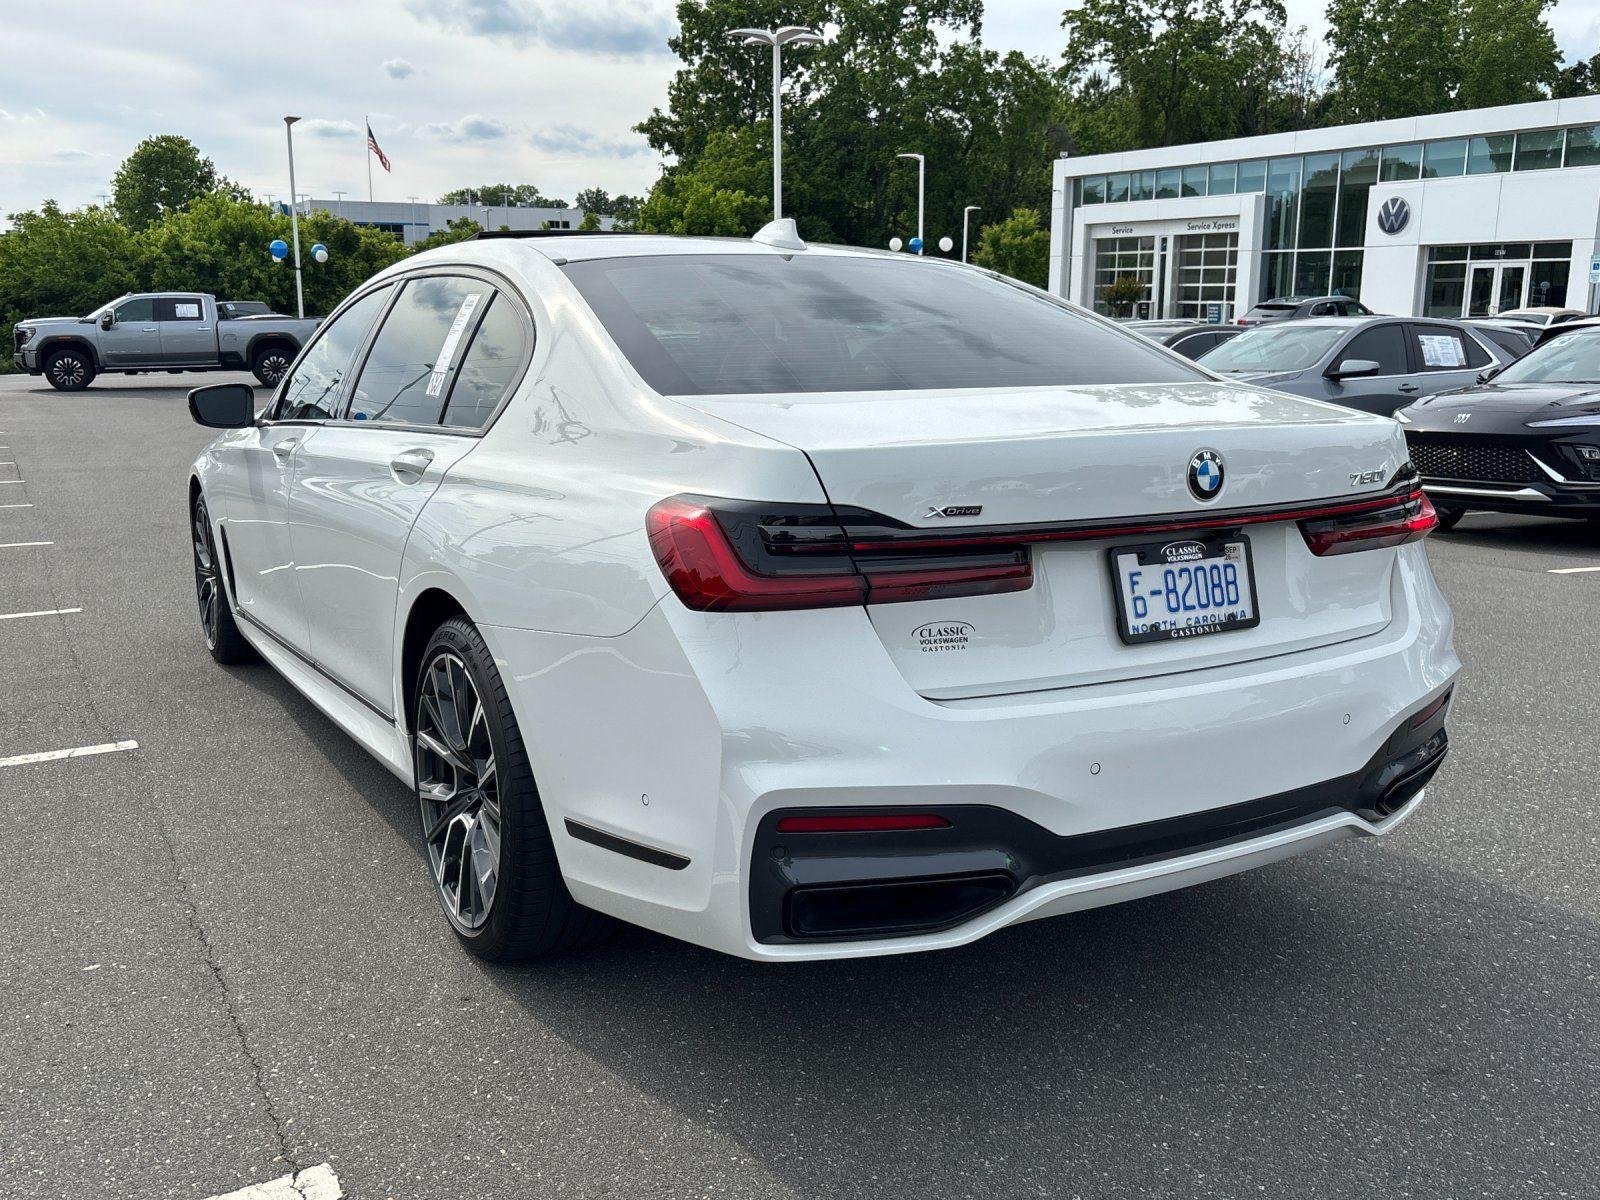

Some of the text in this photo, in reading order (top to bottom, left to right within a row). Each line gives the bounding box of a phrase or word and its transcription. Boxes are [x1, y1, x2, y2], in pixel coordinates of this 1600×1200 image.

[1112, 226, 1133, 235] Service
[1187, 221, 1236, 231] Service Xpress
[1192, 452, 1221, 468] BMW
[1166, 545, 1202, 556] CLASSIC
[1225, 546, 1237, 554] SEP
[1166, 554, 1203, 562] VOLKSWAGEN
[919, 626, 968, 638] CLASSIC
[1171, 624, 1222, 638] GASTONIA
[919, 636, 968, 646] VOLKSWAGEN
[922, 644, 966, 652] GASTONIA
